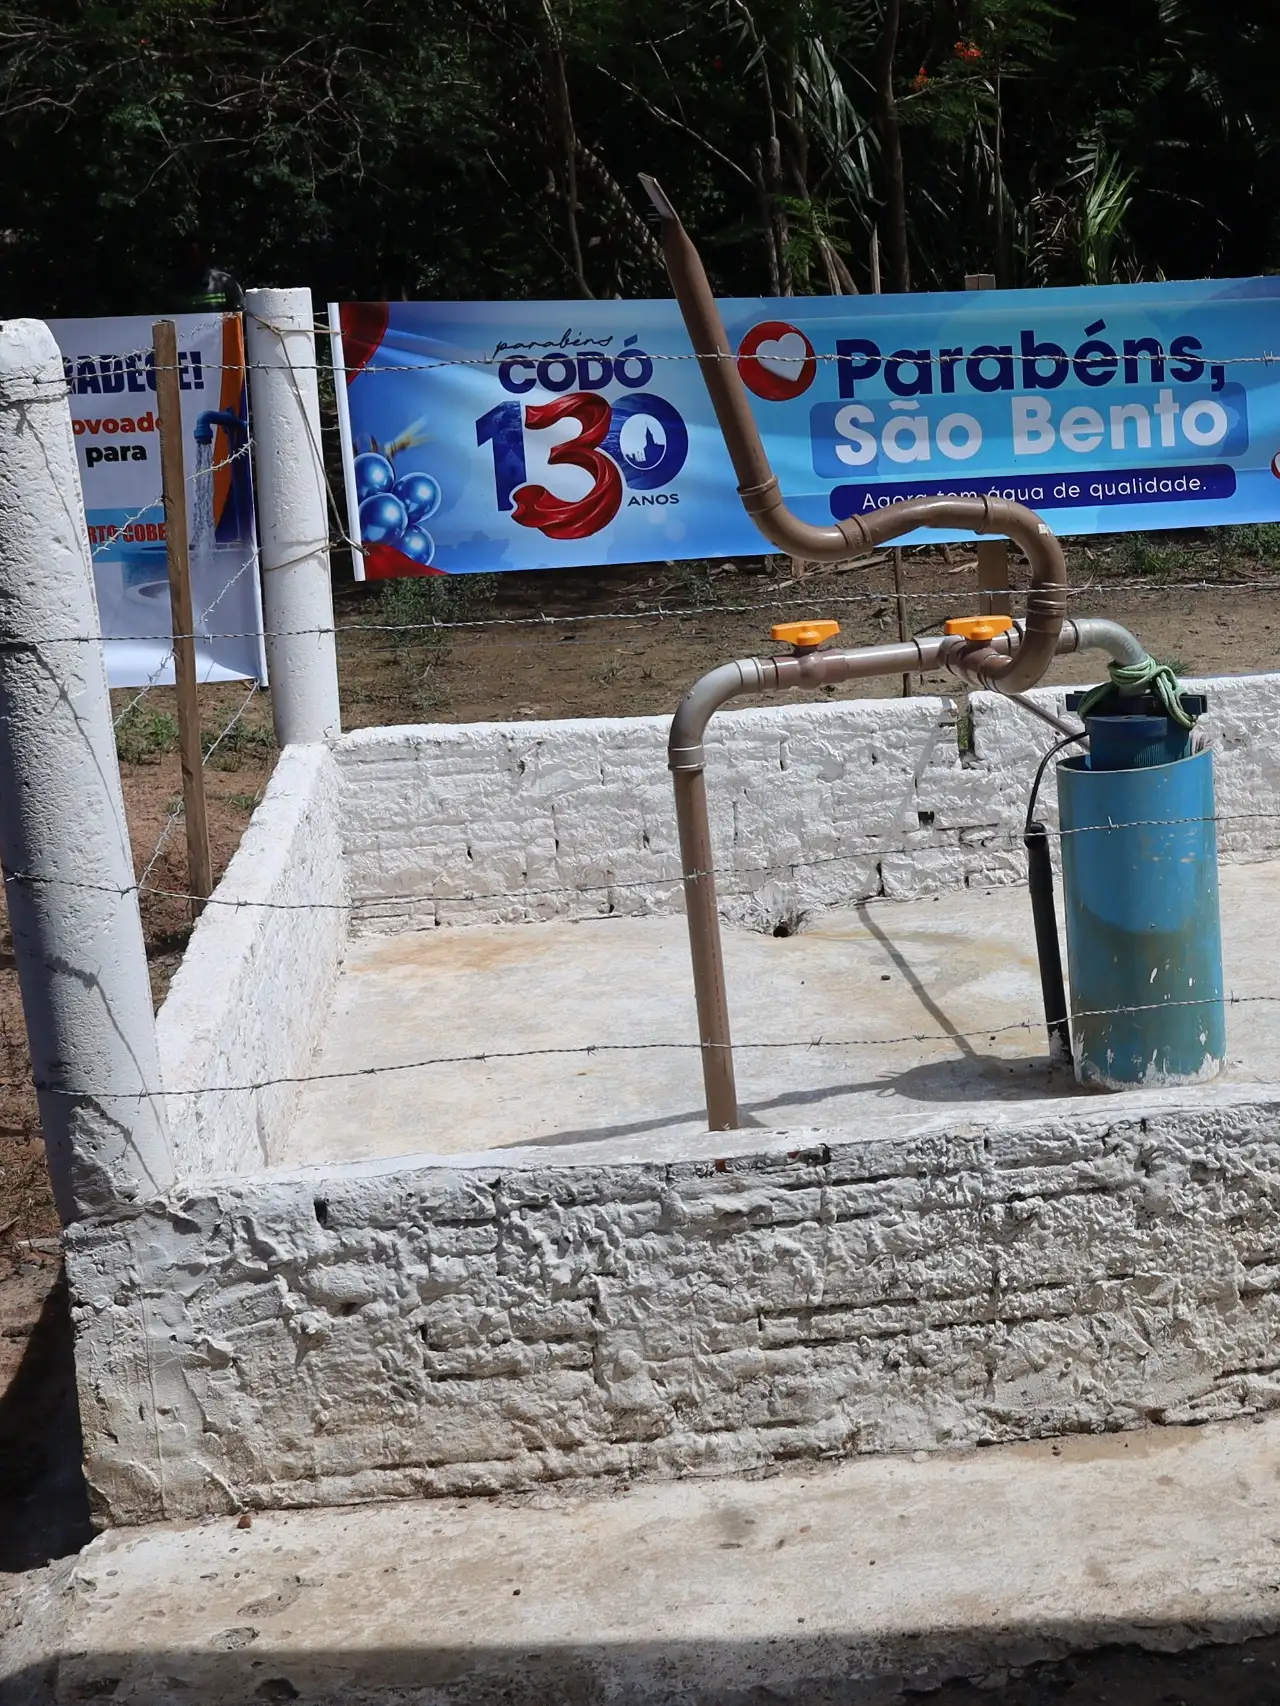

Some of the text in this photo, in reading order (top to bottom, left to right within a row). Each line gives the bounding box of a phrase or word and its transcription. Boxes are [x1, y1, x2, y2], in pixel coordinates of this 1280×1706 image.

[492, 328, 613, 358] parabéns
[498, 334, 653, 394] CODÓ
[834, 319, 1226, 398] Parabéns,
[72, 411, 163, 436] ovoad
[834, 389, 1229, 466] São Bento
[85, 444, 147, 468] para
[475, 391, 689, 541] 130
[627, 493, 680, 507] ANOS
[1053, 481, 1081, 499] de
[1089, 475, 1207, 500] qualidade.
[123, 522, 168, 543] COBE
